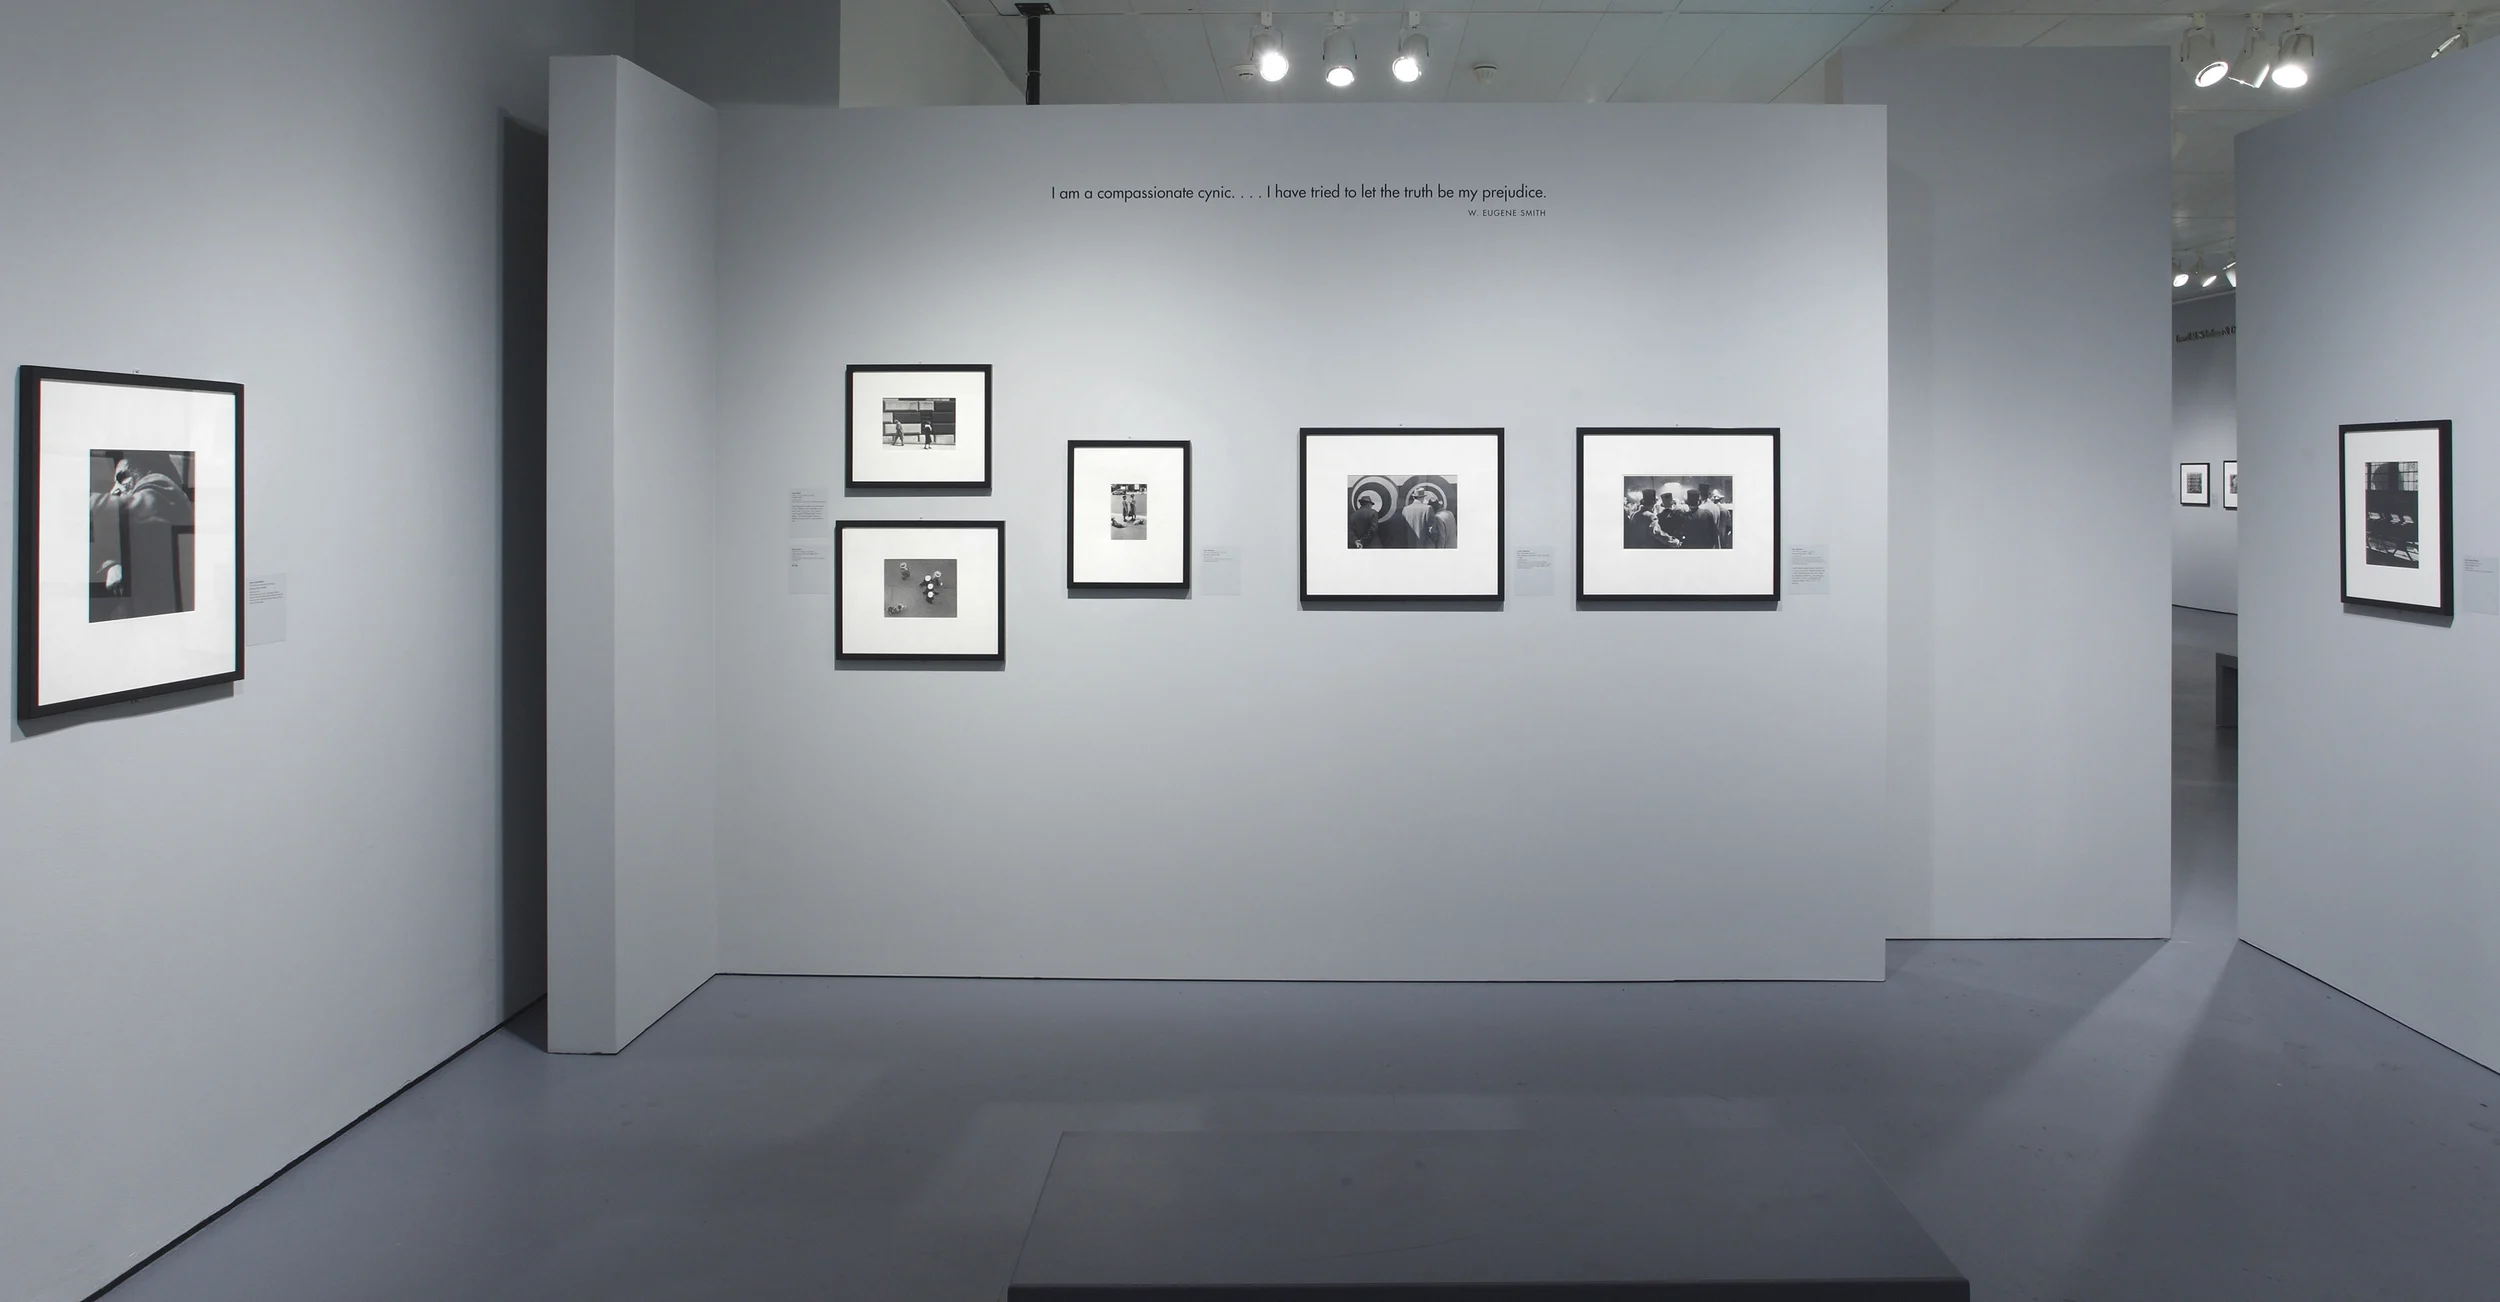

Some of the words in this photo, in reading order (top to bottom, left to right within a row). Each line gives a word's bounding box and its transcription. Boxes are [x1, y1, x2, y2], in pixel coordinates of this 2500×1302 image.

[1051, 186, 1055, 200] I
[1059, 190, 1080, 200] am
[1084, 190, 1093, 200] a
[1097, 185, 1194, 203] compassionate
[1267, 185, 1271, 199] I
[1275, 183, 1307, 199] have
[1310, 183, 1340, 199] tried
[1344, 186, 1357, 199] to
[1361, 183, 1377, 199] let
[1380, 183, 1401, 199] the
[1403, 183, 1434, 199] truth
[1437, 183, 1455, 199] be
[1458, 188, 1479, 202] my
[1482, 183, 1547, 203] prejudice.
[1467, 209, 1479, 217] W.
[1482, 209, 1517, 217] EUGENE
[1520, 209, 1546, 217] SMITH
